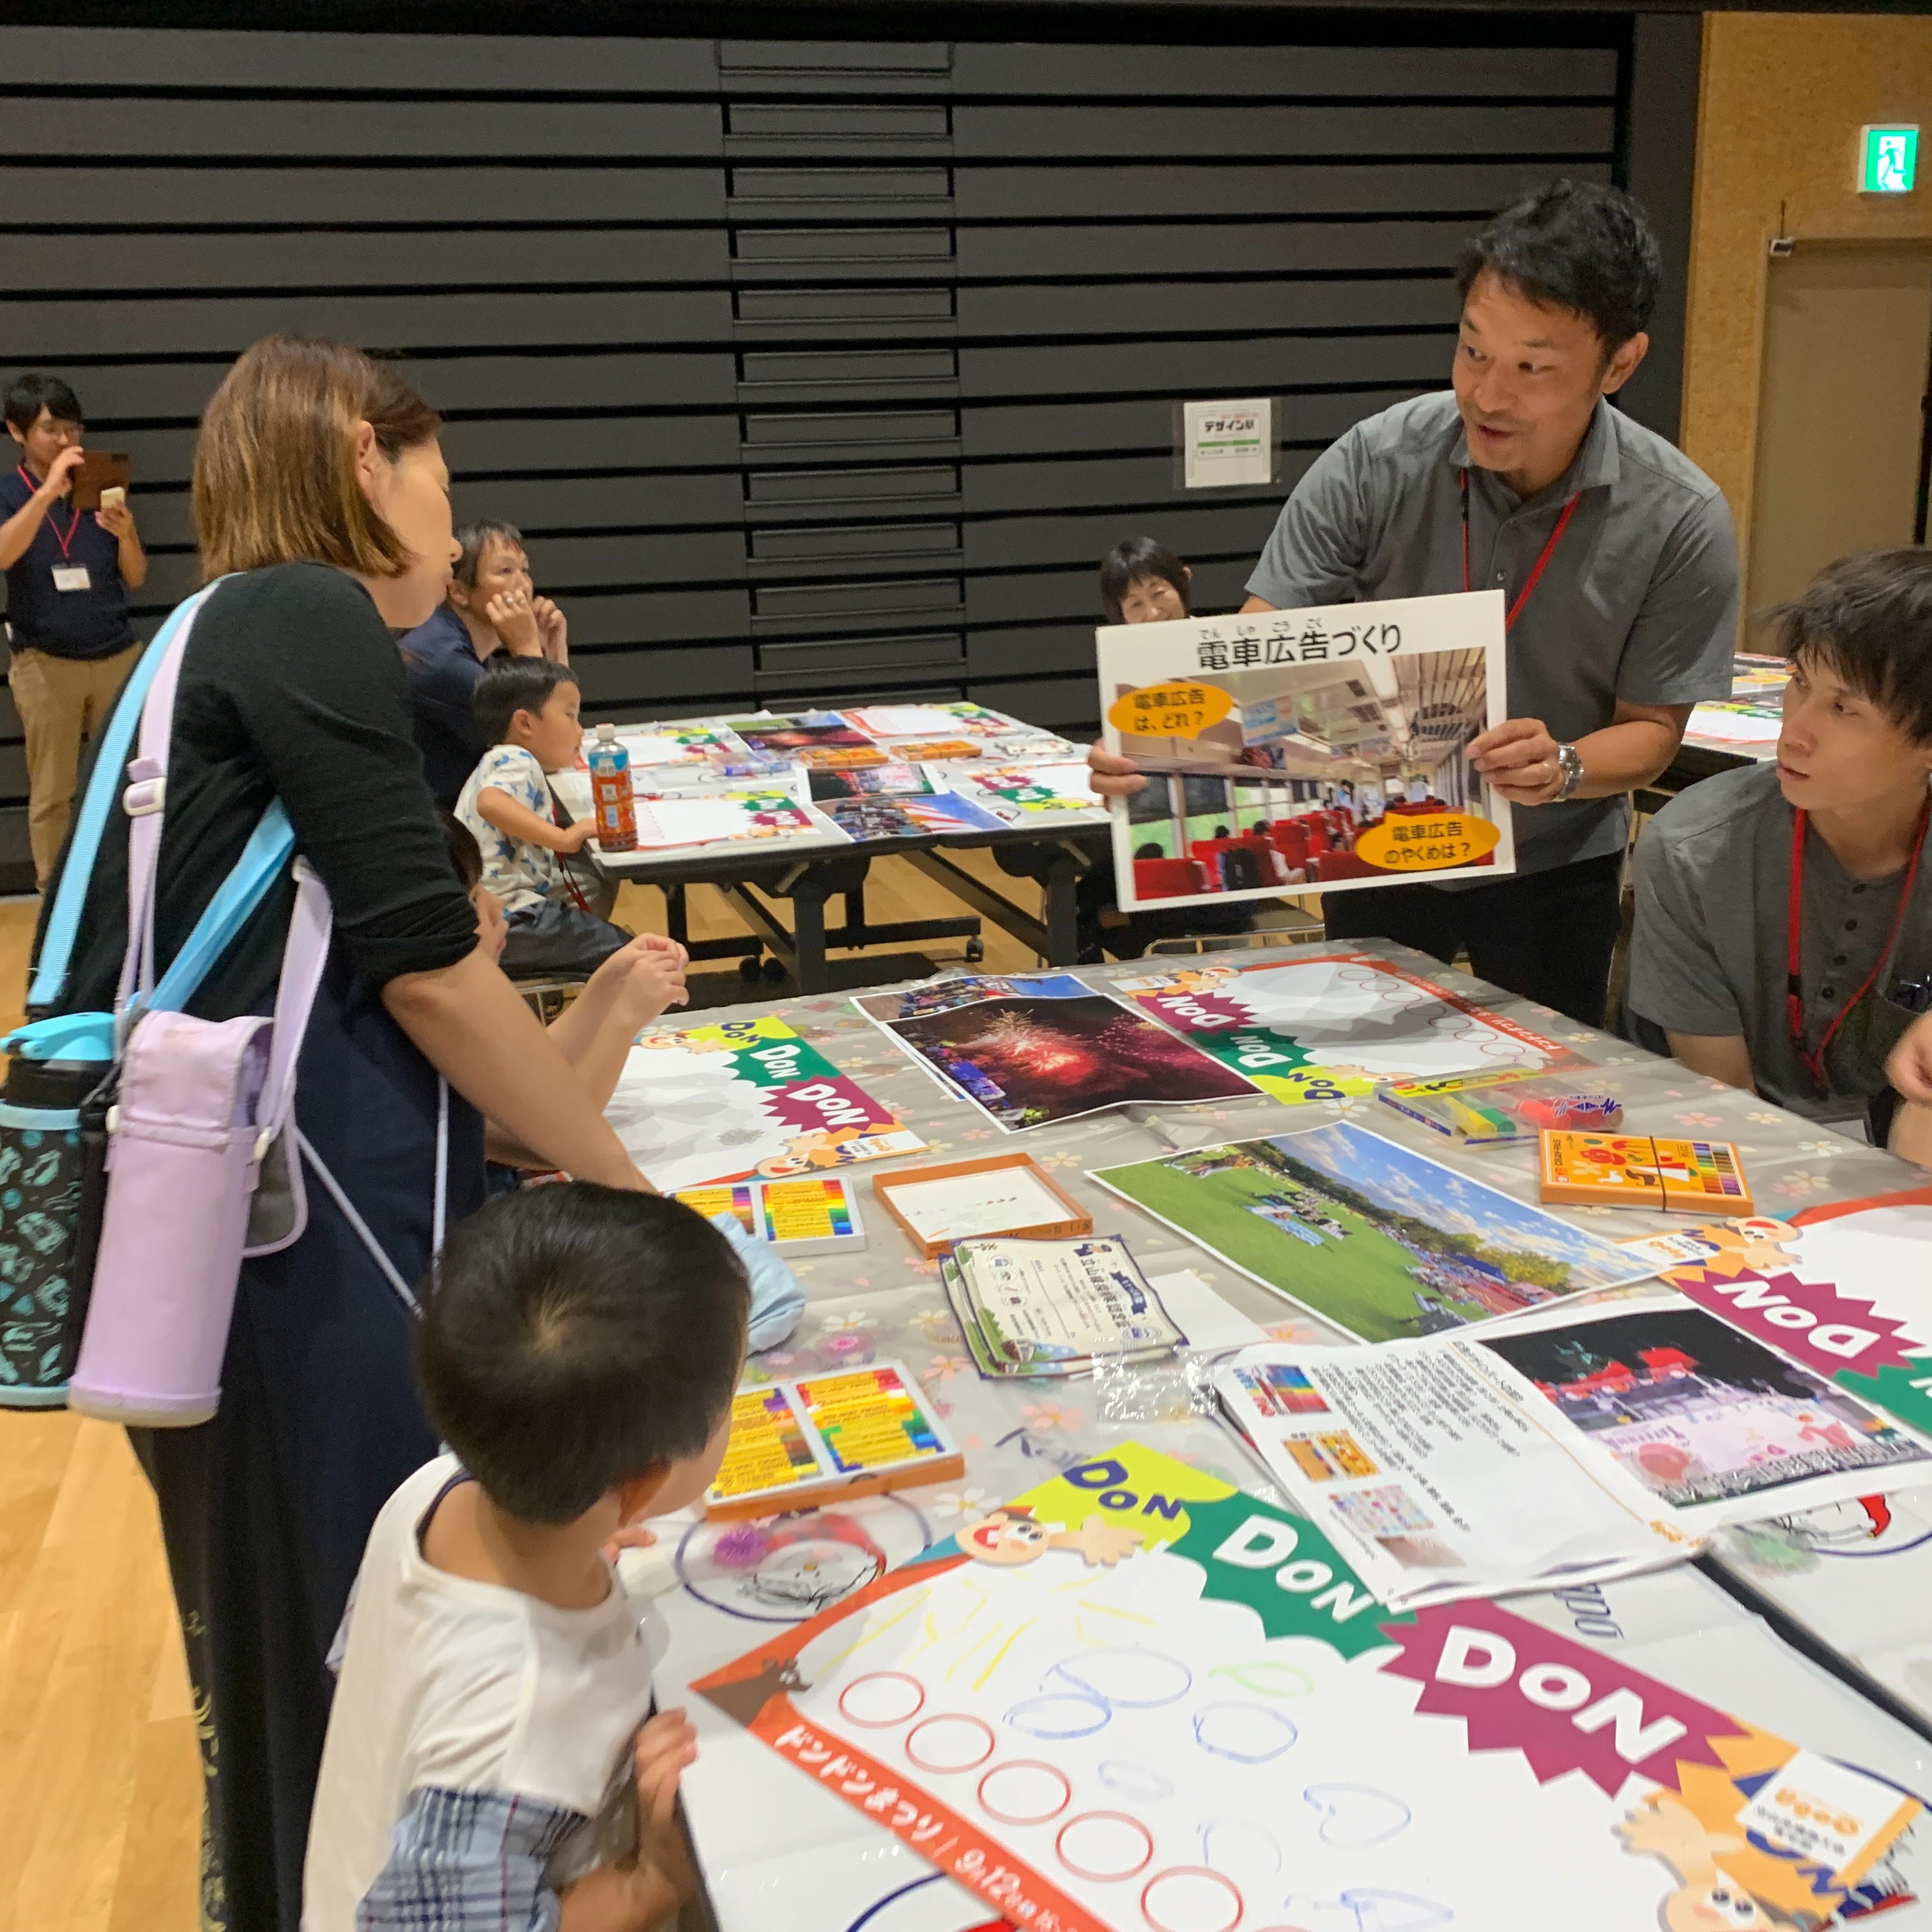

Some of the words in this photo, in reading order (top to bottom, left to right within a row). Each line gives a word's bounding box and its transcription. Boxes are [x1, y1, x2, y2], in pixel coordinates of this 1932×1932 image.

[1197, 624, 1401, 671] 電車広告づくり
[1133, 688, 1205, 710] 電車広告
[1392, 821, 1463, 842] 電車広告
[1156, 995, 1236, 1027] DON
[720, 1022, 762, 1043] DON
[1229, 1035, 1293, 1068] DON
[749, 1044, 801, 1078] DON
[785, 1083, 870, 1126] DON
[1288, 1072, 1346, 1100] DON
[1713, 1280, 1881, 1359] DON
[1063, 1459, 1182, 1520] DON
[1213, 1514, 1375, 1623] DON
[1435, 1625, 1687, 1765] DON
[774, 1725, 944, 1841] ドンドンまつり
